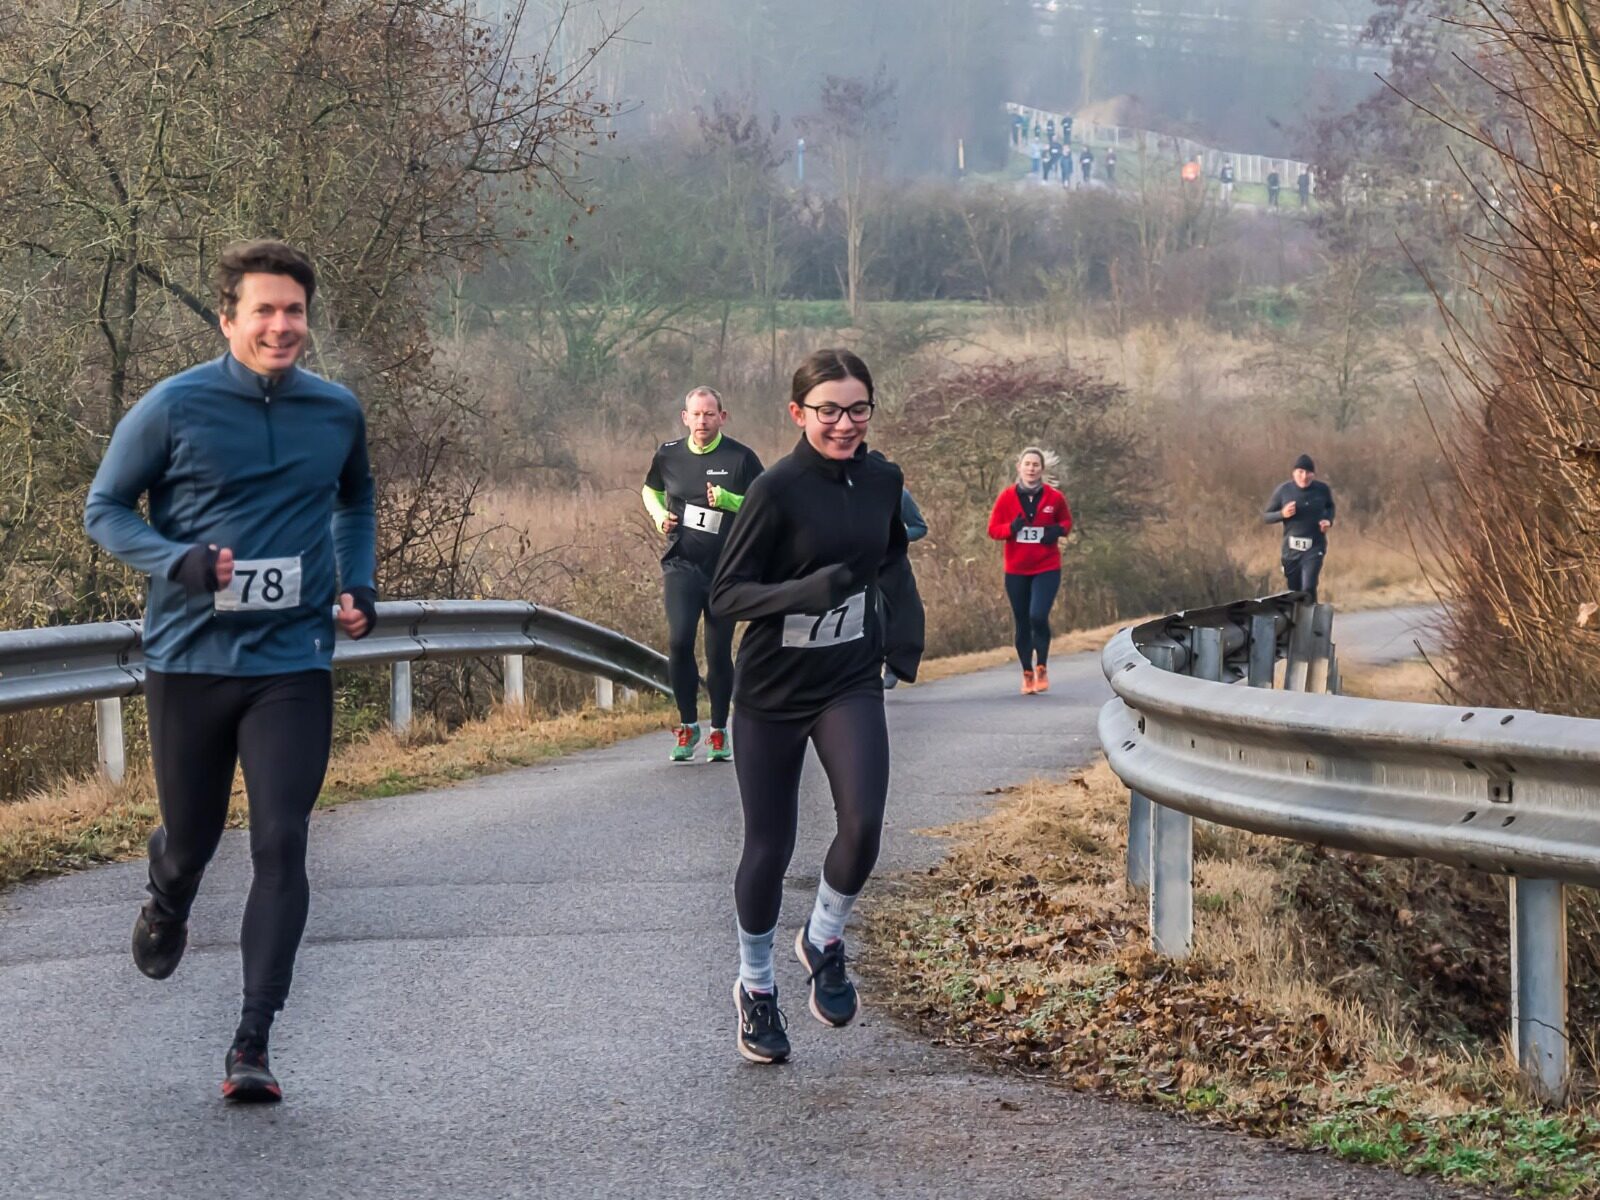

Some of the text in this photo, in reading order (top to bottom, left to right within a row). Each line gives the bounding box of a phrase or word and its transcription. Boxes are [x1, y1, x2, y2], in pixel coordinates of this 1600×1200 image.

[696, 512, 706, 528] 1
[1023, 530, 1038, 541] 13
[234, 567, 284, 604] 78
